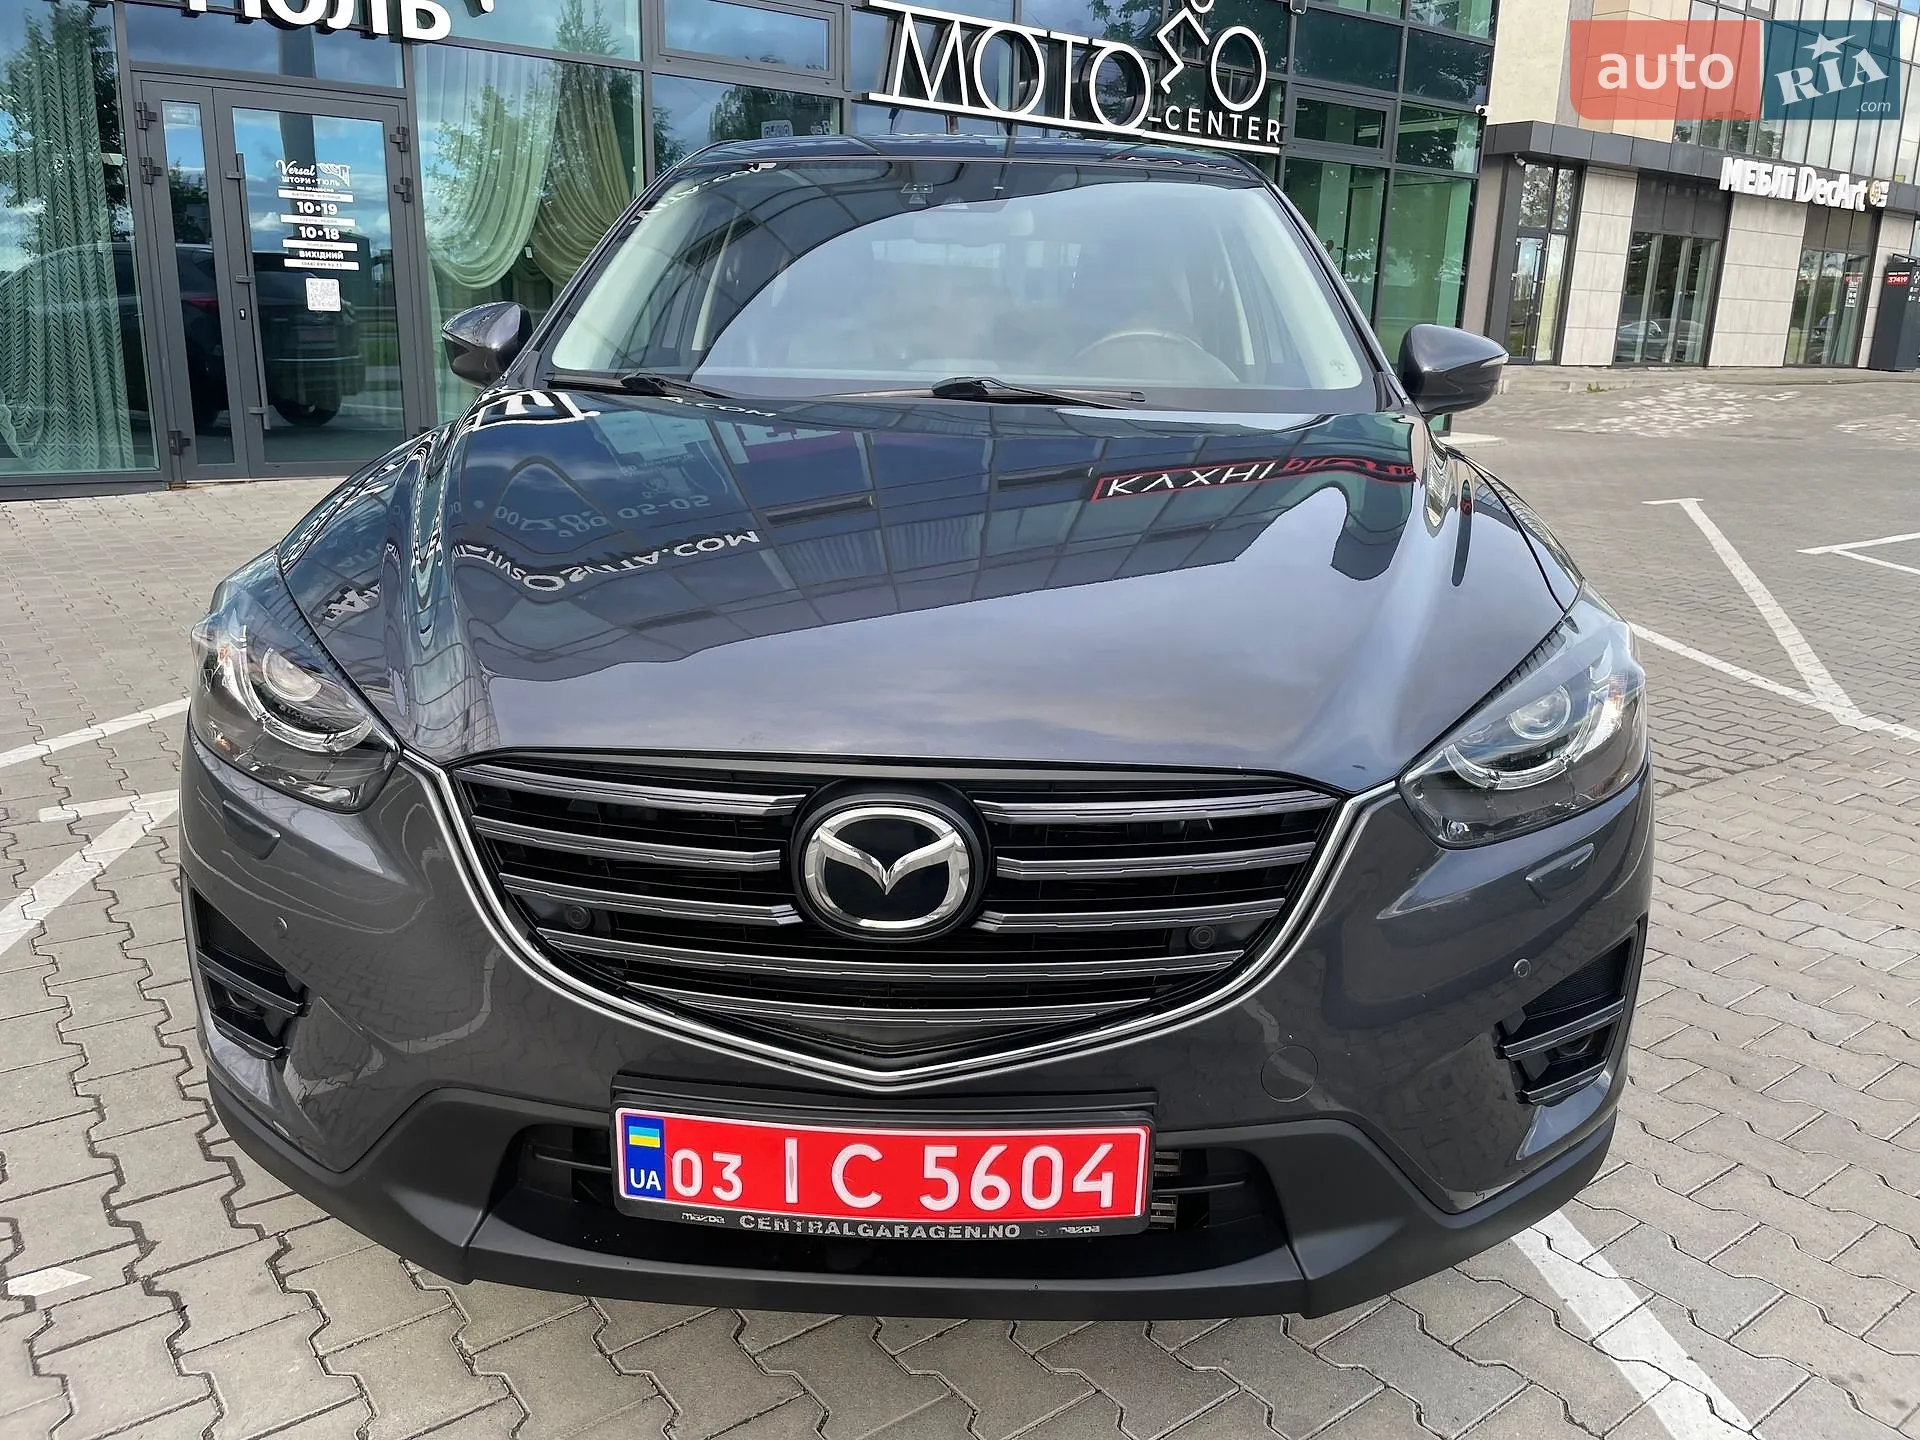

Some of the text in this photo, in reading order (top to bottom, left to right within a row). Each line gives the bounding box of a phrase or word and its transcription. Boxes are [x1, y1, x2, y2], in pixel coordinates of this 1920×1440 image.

[276, 160, 316, 176] Versal
[281, 176, 311, 184] ШТОРИ
[1796, 166, 1868, 211] DecArt
[299, 250, 344, 260] ВИХІДНИЙ
[630, 1167, 661, 1191] UA
[671, 1148, 744, 1202] 03
[919, 1143, 1114, 1211] 5604
[739, 1214, 1021, 1239] CENTRALGARAGEN.NO
